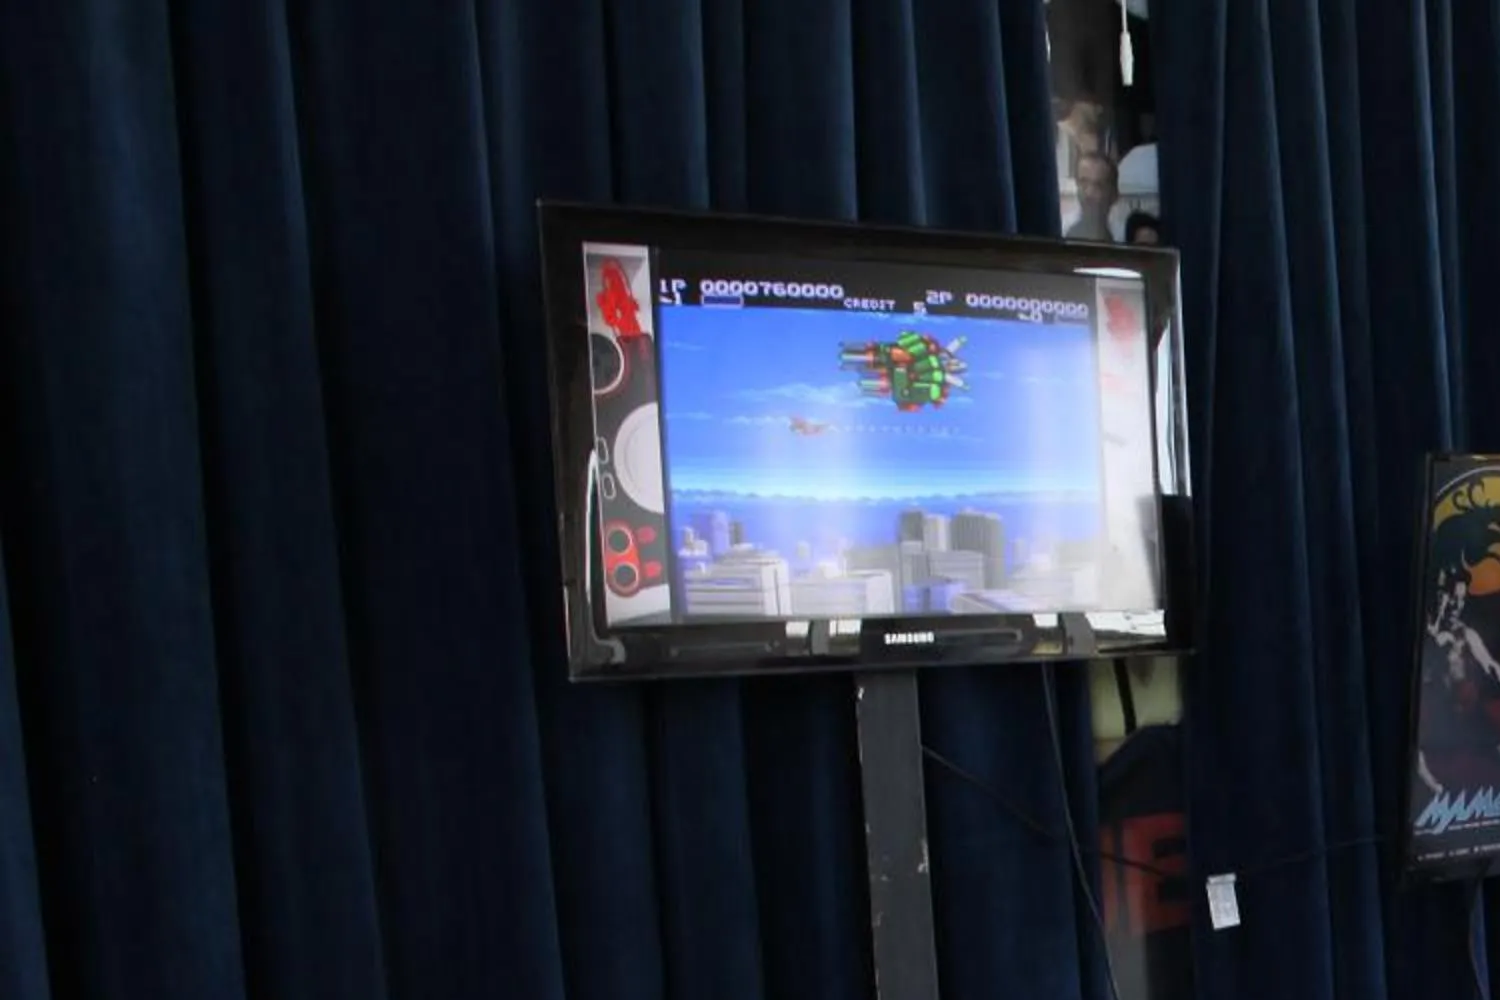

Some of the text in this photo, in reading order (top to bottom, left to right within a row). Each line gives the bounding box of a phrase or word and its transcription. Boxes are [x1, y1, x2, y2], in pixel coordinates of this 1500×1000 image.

[700, 279, 844, 299] 0000760000
[926, 290, 952, 304] 2P
[843, 299, 895, 311] CREDIT
